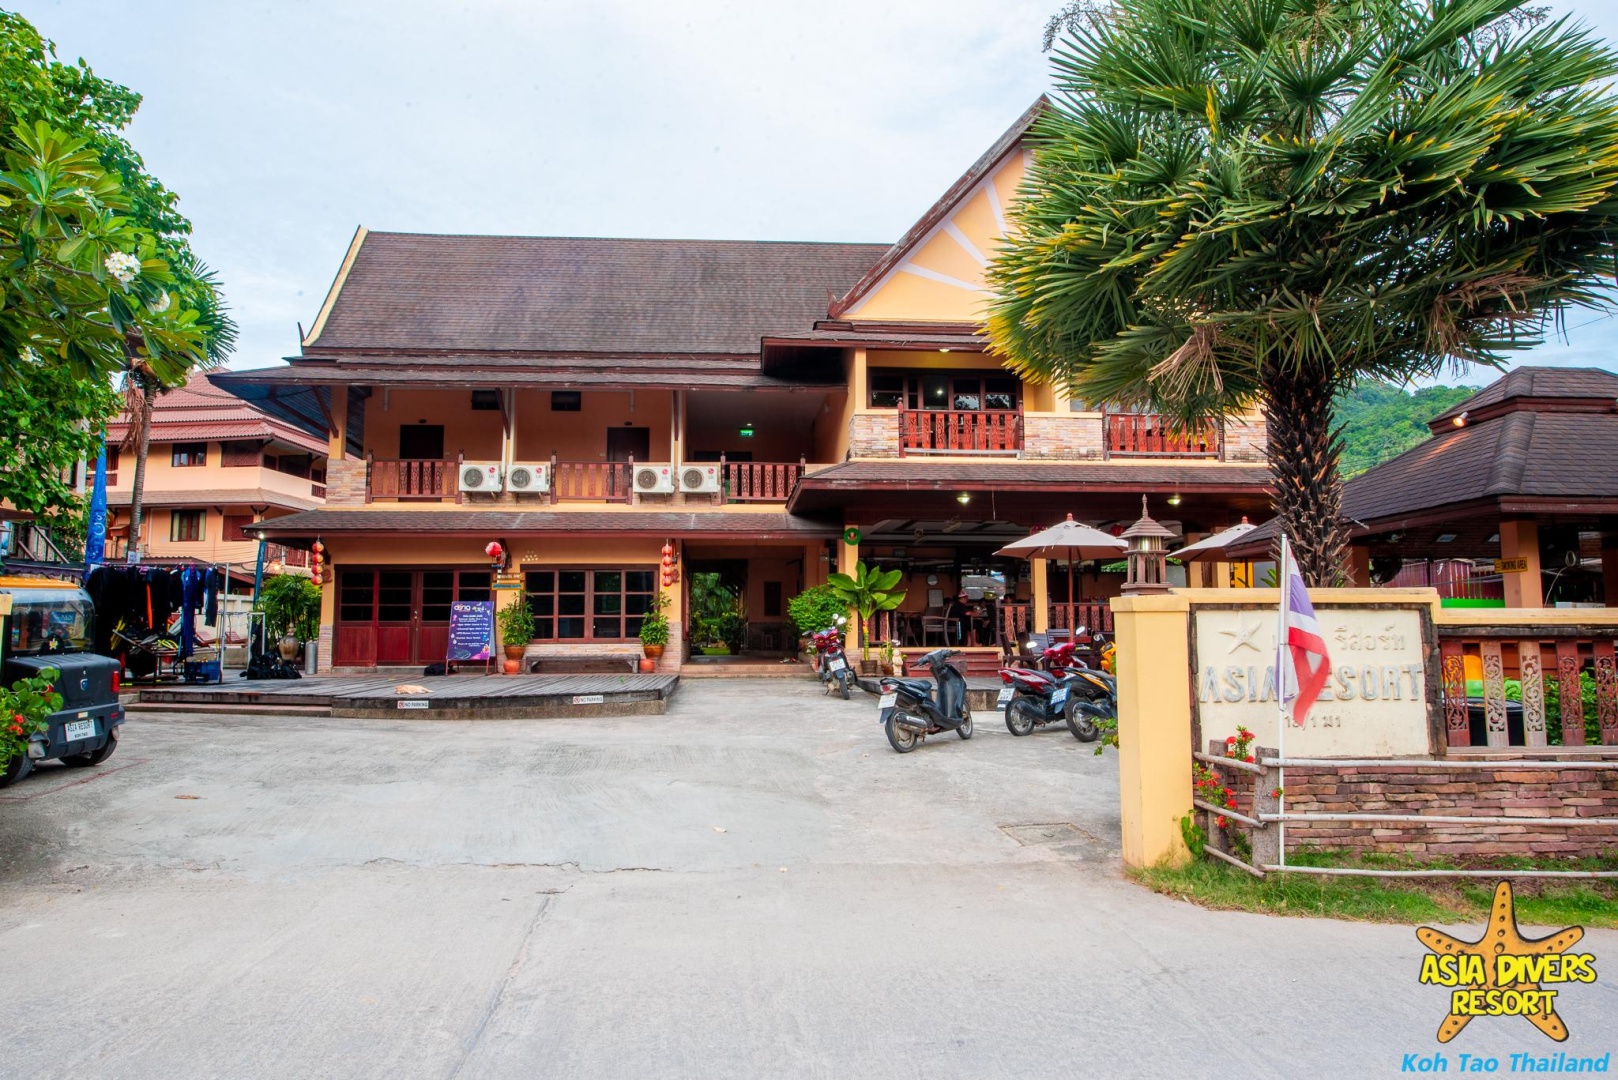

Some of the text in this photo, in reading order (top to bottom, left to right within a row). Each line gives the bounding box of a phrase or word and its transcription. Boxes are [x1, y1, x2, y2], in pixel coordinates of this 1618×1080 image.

[1501, 559, 1527, 570] SMOKING AREA
[1200, 665, 1277, 703] ASIA
[67, 720, 92, 732] ASIA RESORT
